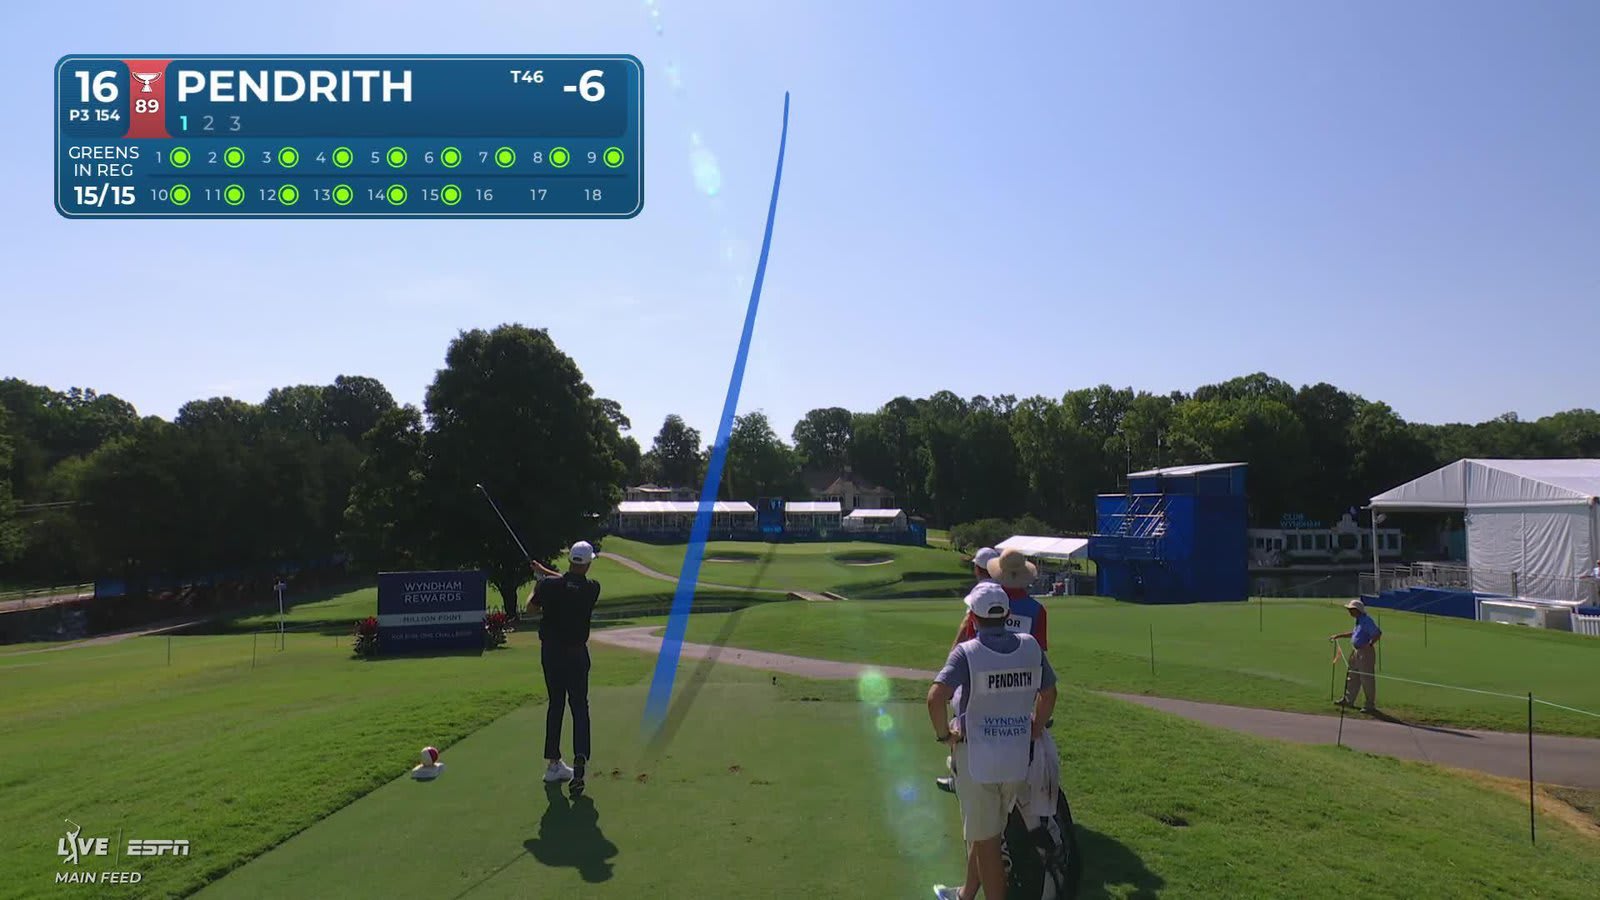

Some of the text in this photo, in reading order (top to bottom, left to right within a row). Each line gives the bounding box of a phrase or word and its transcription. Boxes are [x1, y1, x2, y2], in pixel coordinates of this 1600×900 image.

[404, 581, 462, 592] WYNDHAM
[404, 592, 462, 604] REWARDS
[1003, 617, 1021, 628] OR
[988, 671, 1032, 690] PENDRITH
